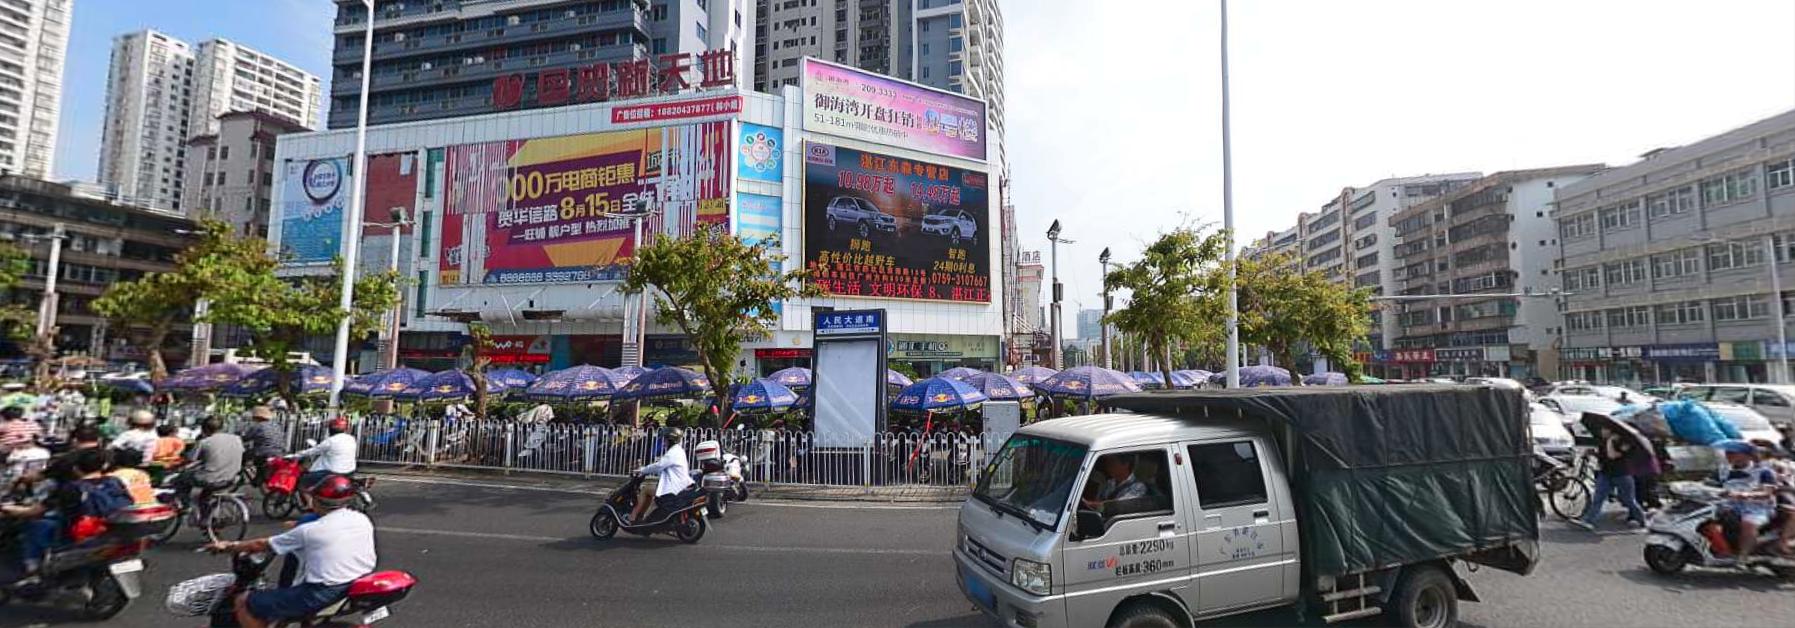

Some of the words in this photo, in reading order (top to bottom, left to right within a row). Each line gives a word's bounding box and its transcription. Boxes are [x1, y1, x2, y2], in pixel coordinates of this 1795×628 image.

[819, 250, 897, 267] 高性价比越野车
[823, 314, 875, 326] 人民大道南
